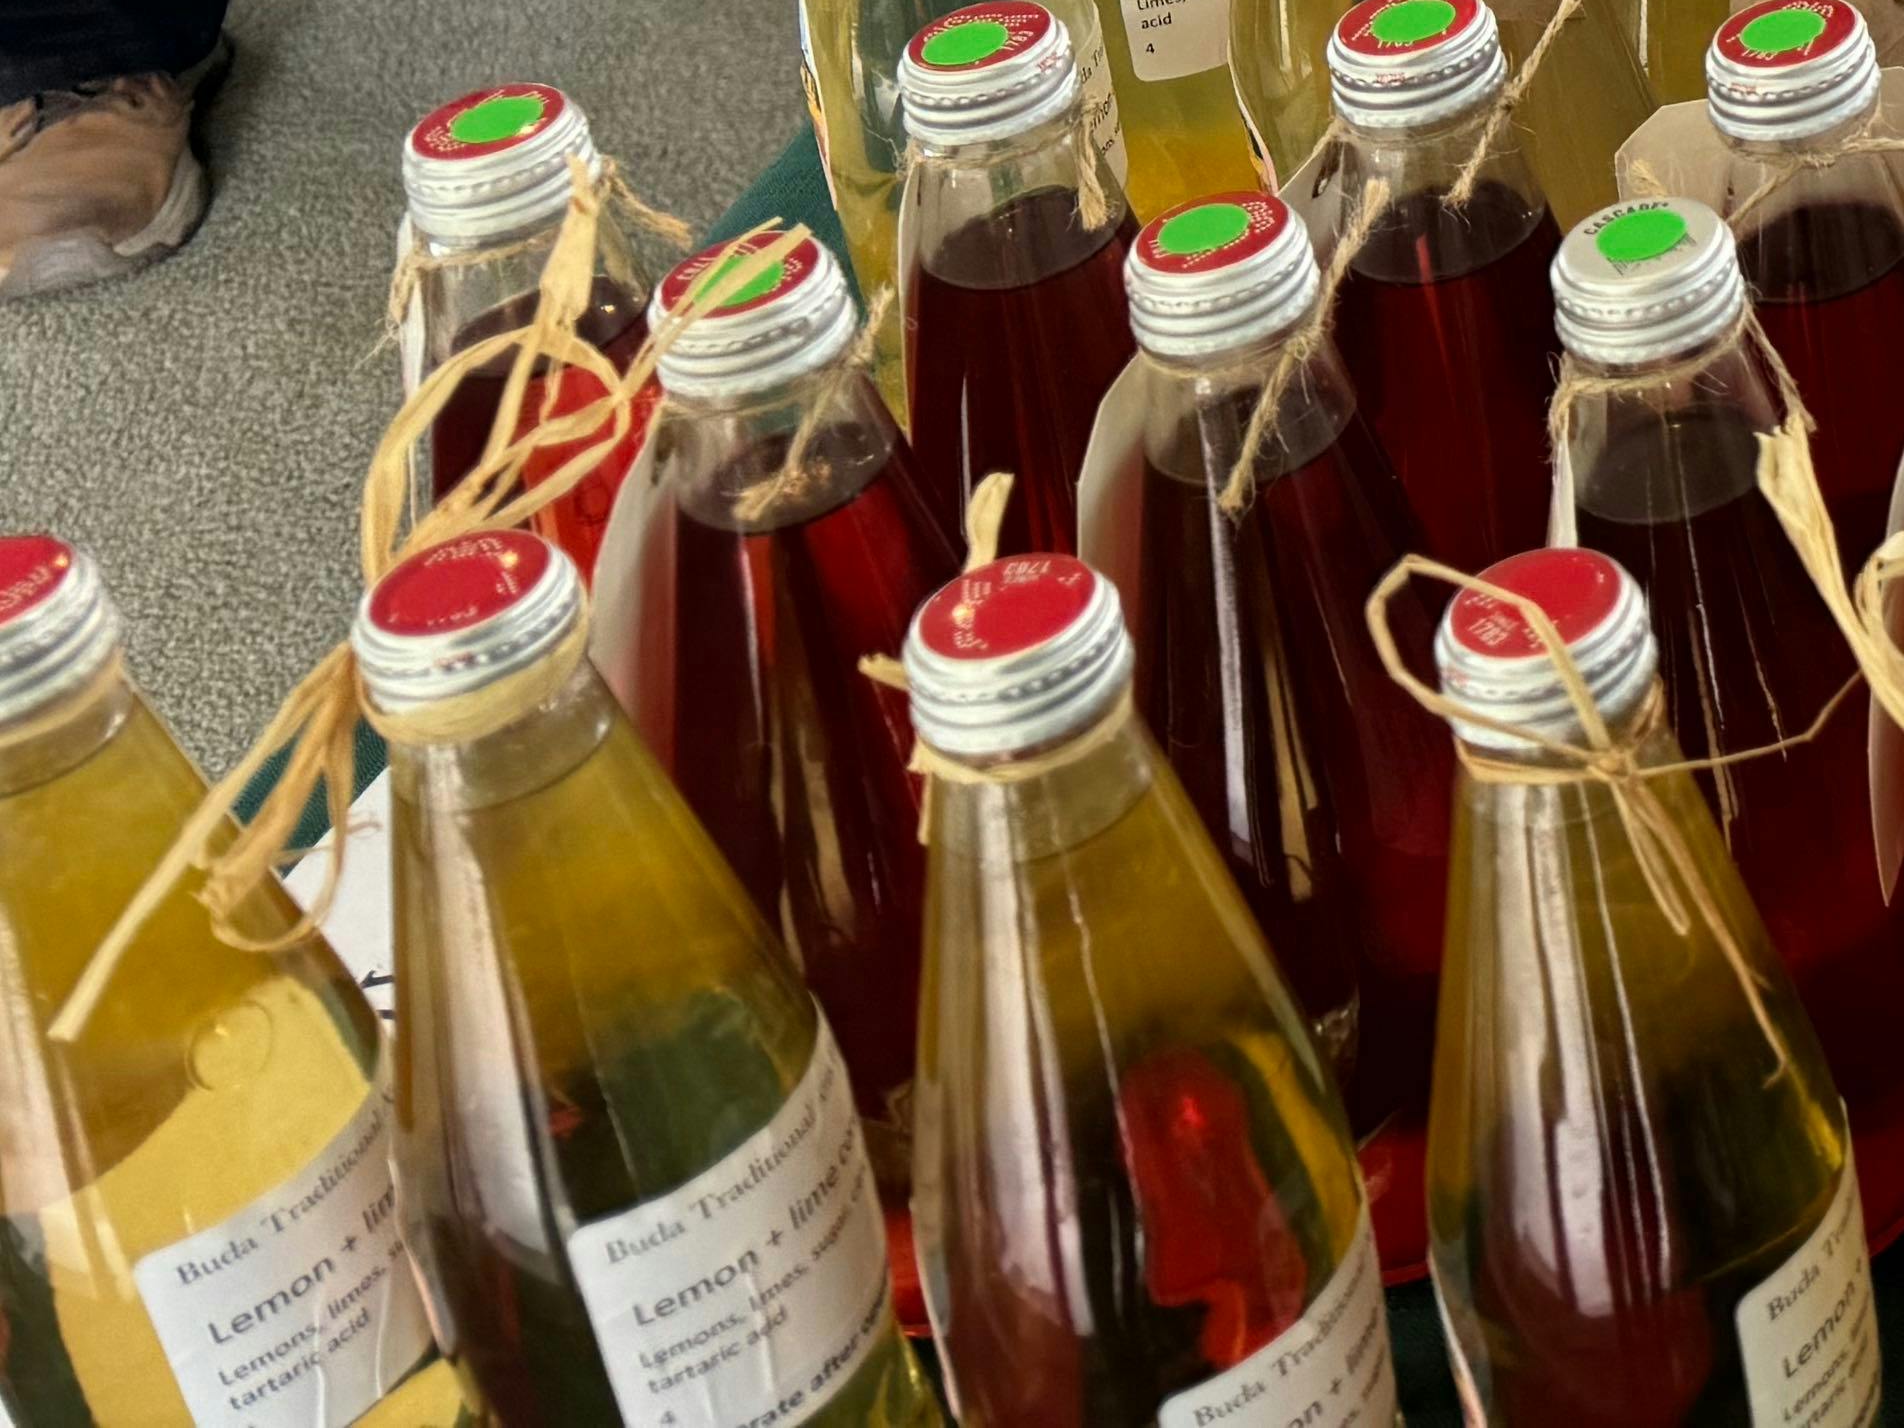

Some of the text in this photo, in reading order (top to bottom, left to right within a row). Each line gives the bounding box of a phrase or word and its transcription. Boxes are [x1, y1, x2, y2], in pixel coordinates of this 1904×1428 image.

[1141, 12, 1173, 30] acid
[1145, 43, 1155, 55] 4
[176, 1110, 382, 1286] Buda Traditional
[606, 1219, 686, 1266] Buda
[689, 1103, 818, 1221] Traditional
[207, 1184, 396, 1345] Lemon + lim
[632, 1247, 760, 1329] Lemon
[766, 1228, 785, 1248] +
[788, 1164, 840, 1232] lime
[1767, 1264, 1822, 1321] Buda
[1783, 1280, 1857, 1379] Lemon
[229, 1308, 371, 1412] tartaric acid
[647, 1339, 742, 1395] tartaric
[809, 1334, 860, 1393] after
[1193, 1380, 1266, 1428] Buda
